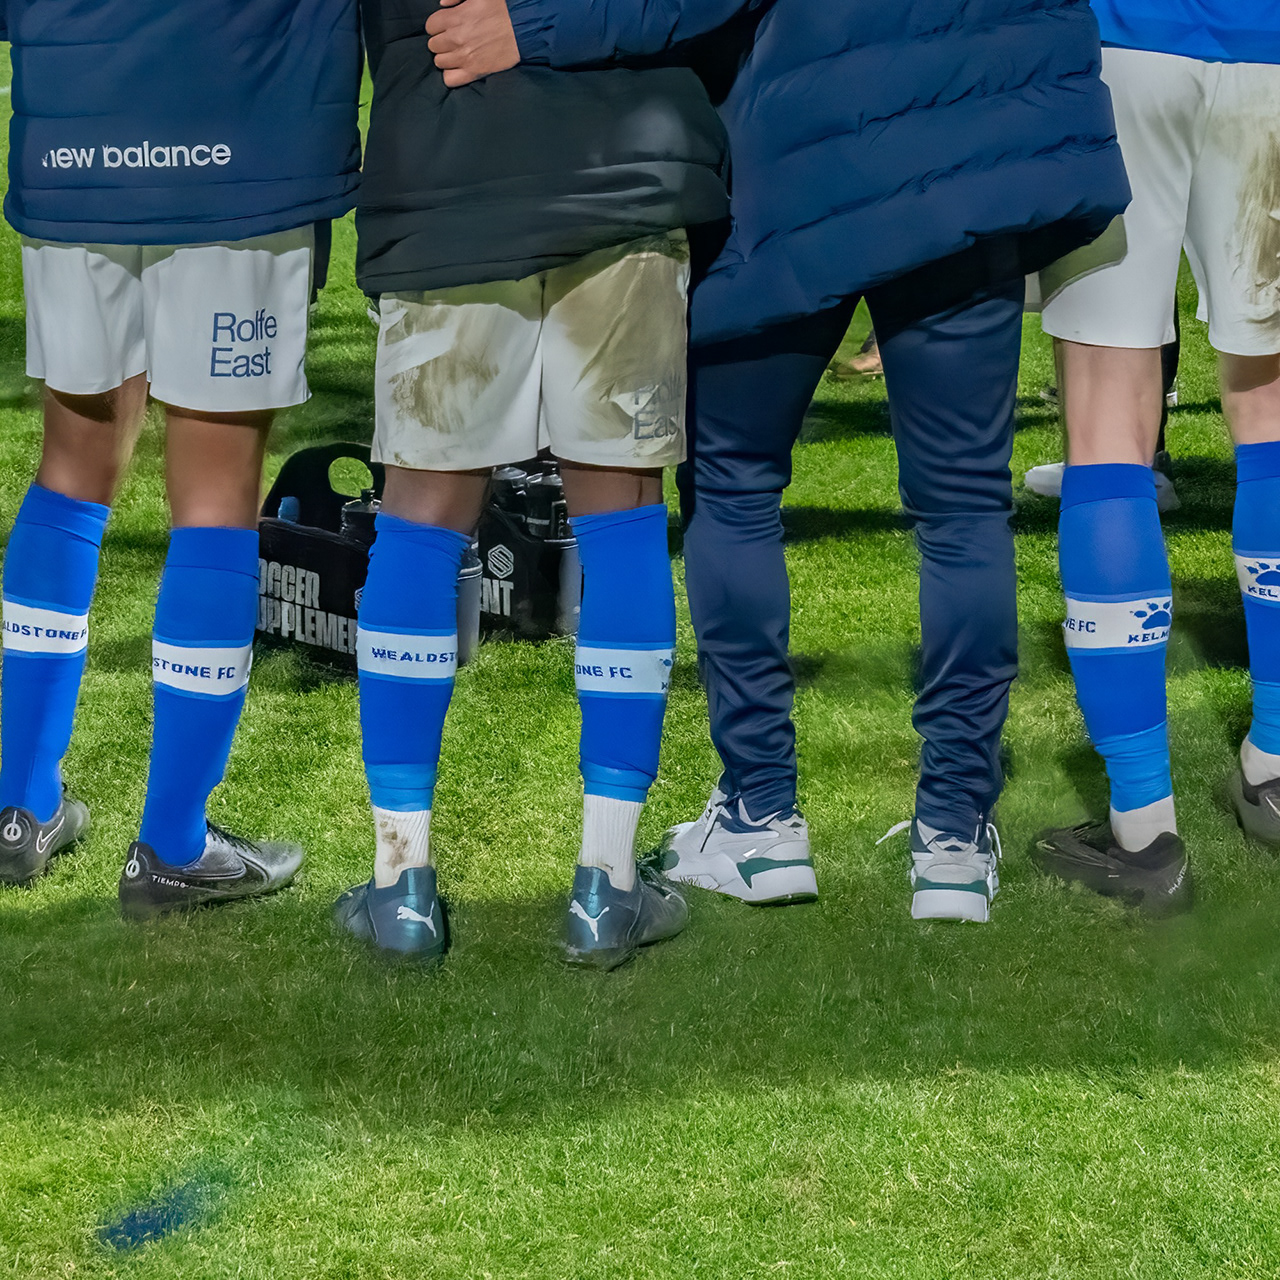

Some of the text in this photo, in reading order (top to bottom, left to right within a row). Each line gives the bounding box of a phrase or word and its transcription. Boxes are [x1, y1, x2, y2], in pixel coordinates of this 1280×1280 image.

[102, 140, 232, 169] balance
[212, 307, 278, 343] Rolfe
[210, 346, 272, 378] East
[1078, 620, 1096, 633] FC
[217, 666, 236, 680] FC
[609, 666, 633, 679] FC
